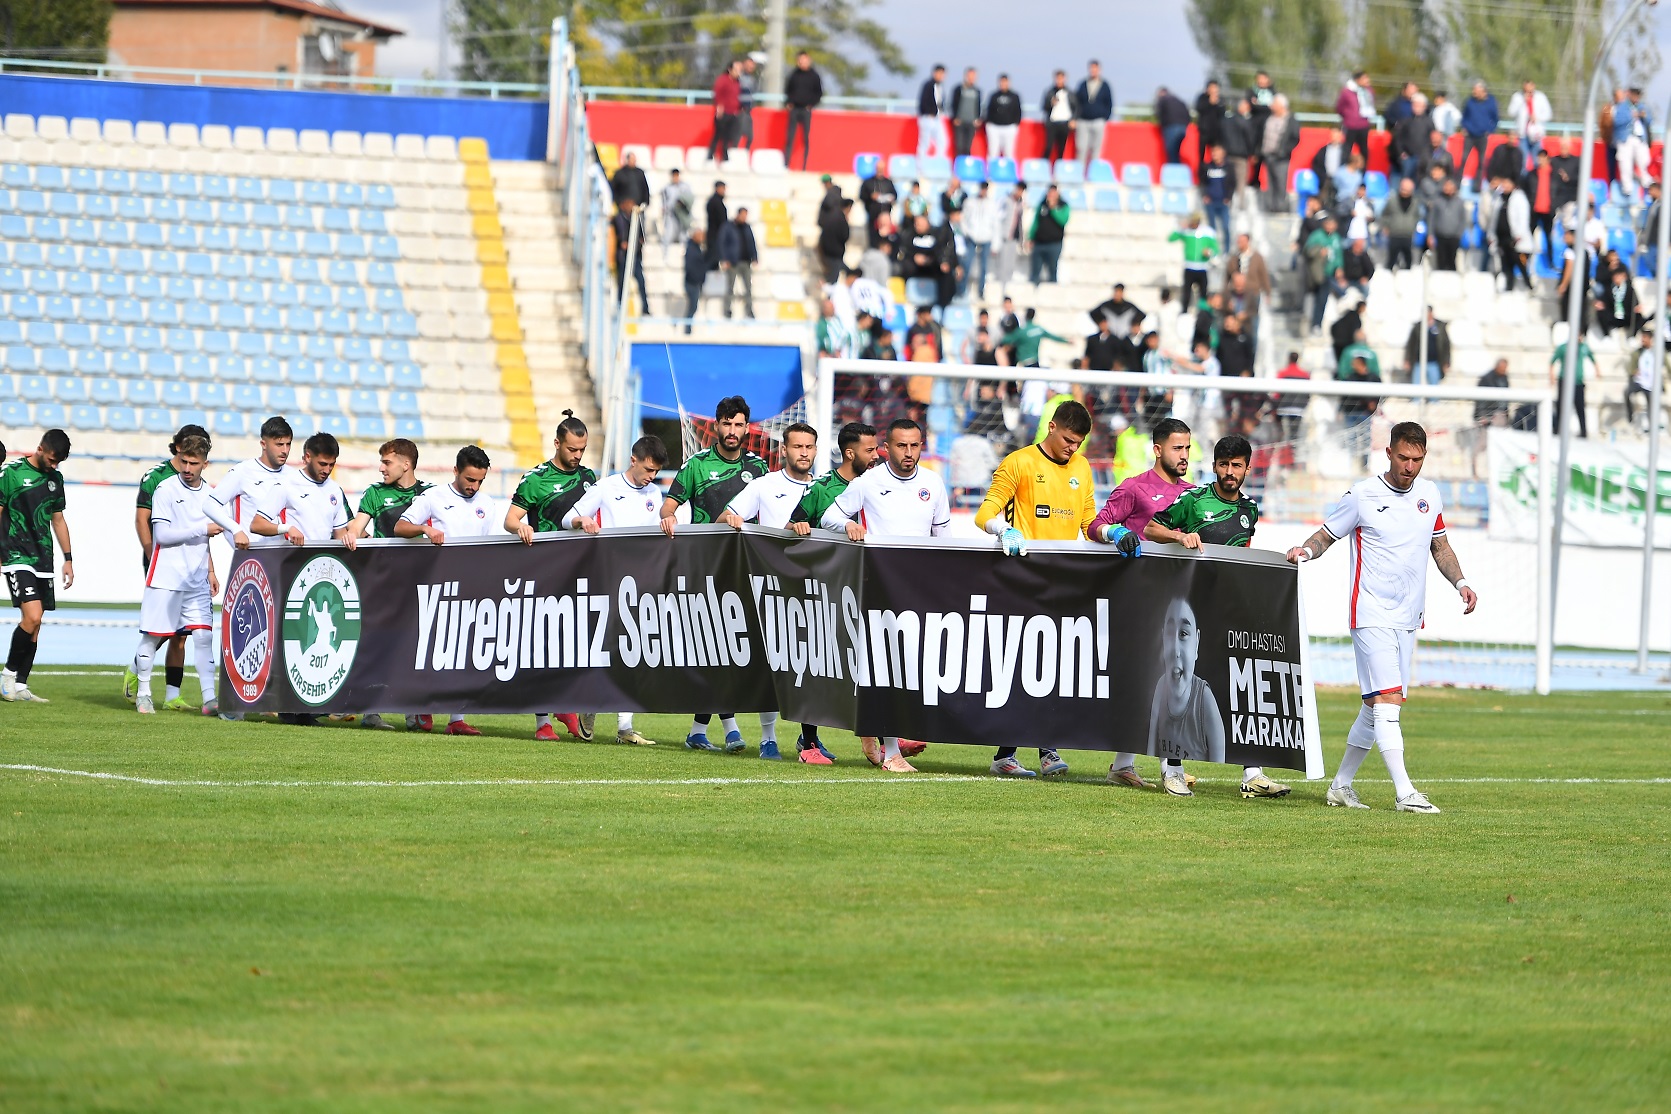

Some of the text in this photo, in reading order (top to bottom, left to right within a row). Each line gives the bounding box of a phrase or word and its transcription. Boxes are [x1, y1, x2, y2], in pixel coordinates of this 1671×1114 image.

[224, 564, 274, 613] KIRIKKALE FK
[414, 577, 611, 682] Yüreğimiz
[618, 575, 751, 668] Seninle
[841, 585, 1110, 709] Şmpiyon!
[1228, 630, 1286, 653] DMD HASTASI
[309, 653, 329, 669] 2017
[242, 685, 258, 697] 1989
[290, 663, 346, 697] KIRŞEHİR FSK
[1229, 657, 1304, 718] METE
